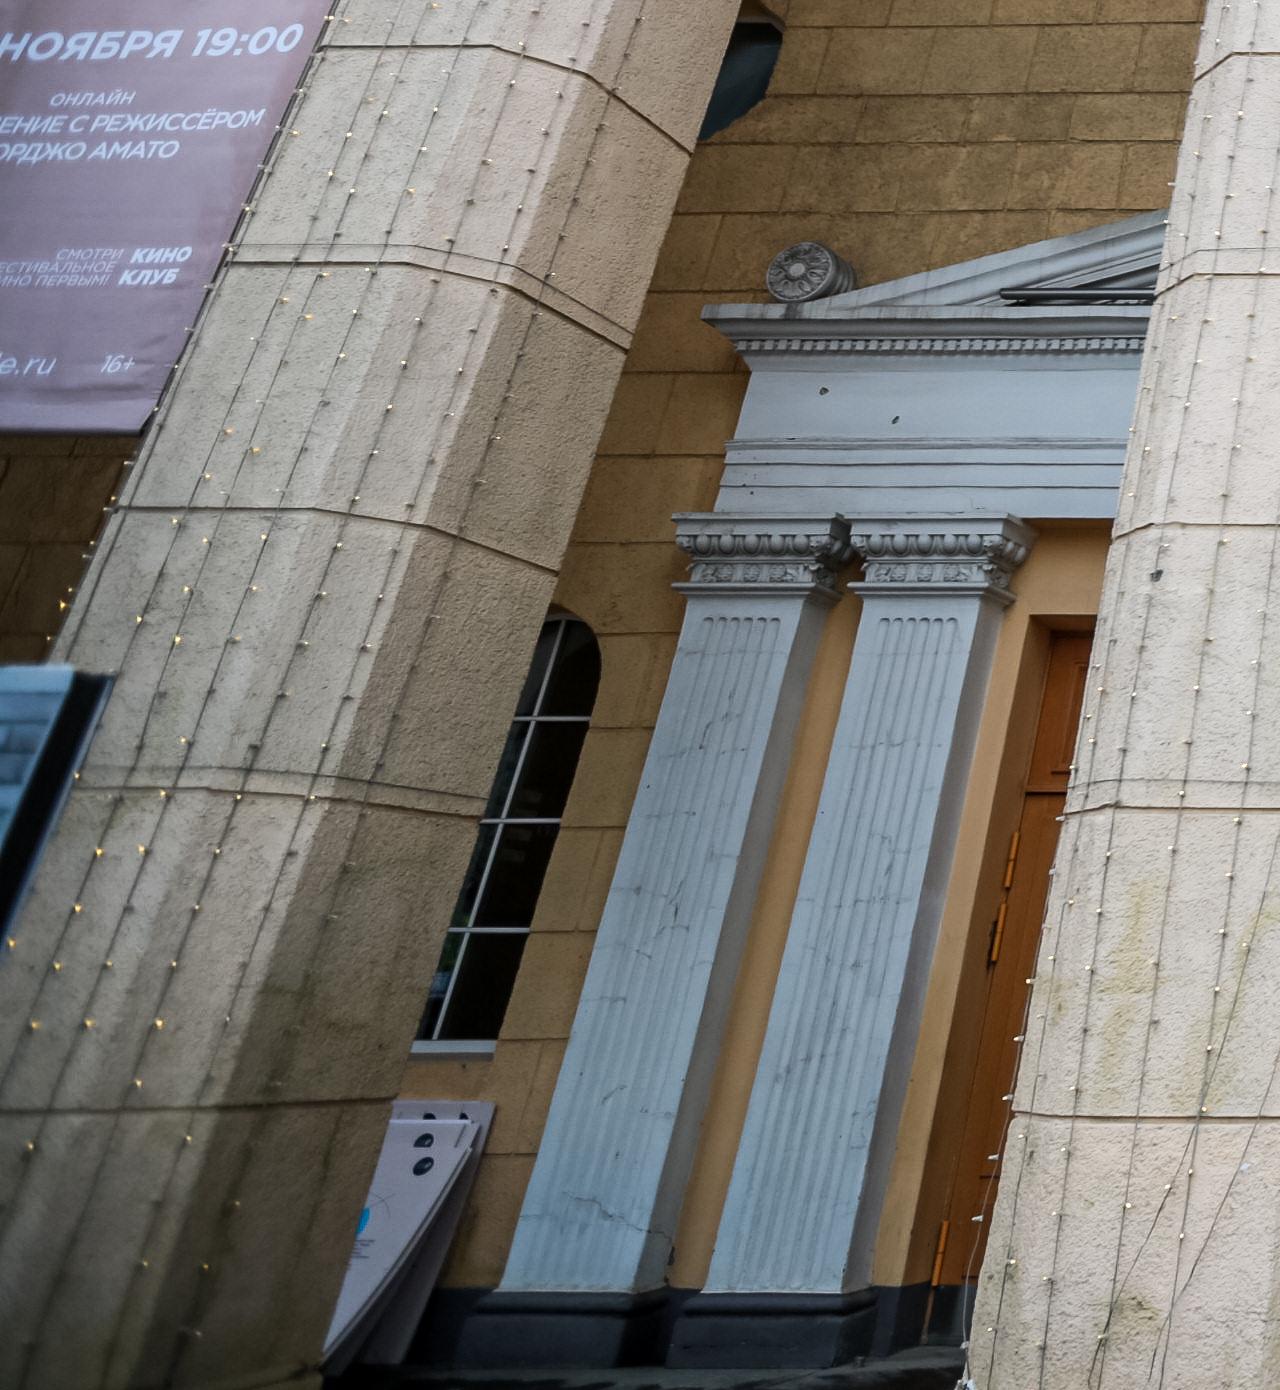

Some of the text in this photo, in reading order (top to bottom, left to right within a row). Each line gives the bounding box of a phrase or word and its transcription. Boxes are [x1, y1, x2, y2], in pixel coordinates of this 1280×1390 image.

[0, 23, 304, 62] НОЯБРЯ 19:00
[50, 89, 136, 107] ОНЛАЙН
[0, 108, 265, 134] ЕНИЕ С РЕЖИССЁРОМ
[88, 140, 180, 160] АМАТО
[56, 249, 124, 261] СМОТРИ
[130, 246, 193, 264] КИНО
[34, 274, 110, 288] ПЕРВЫМ!
[118, 268, 180, 285] КЛУБ
[0, 352, 136, 376] e.ru 16+
